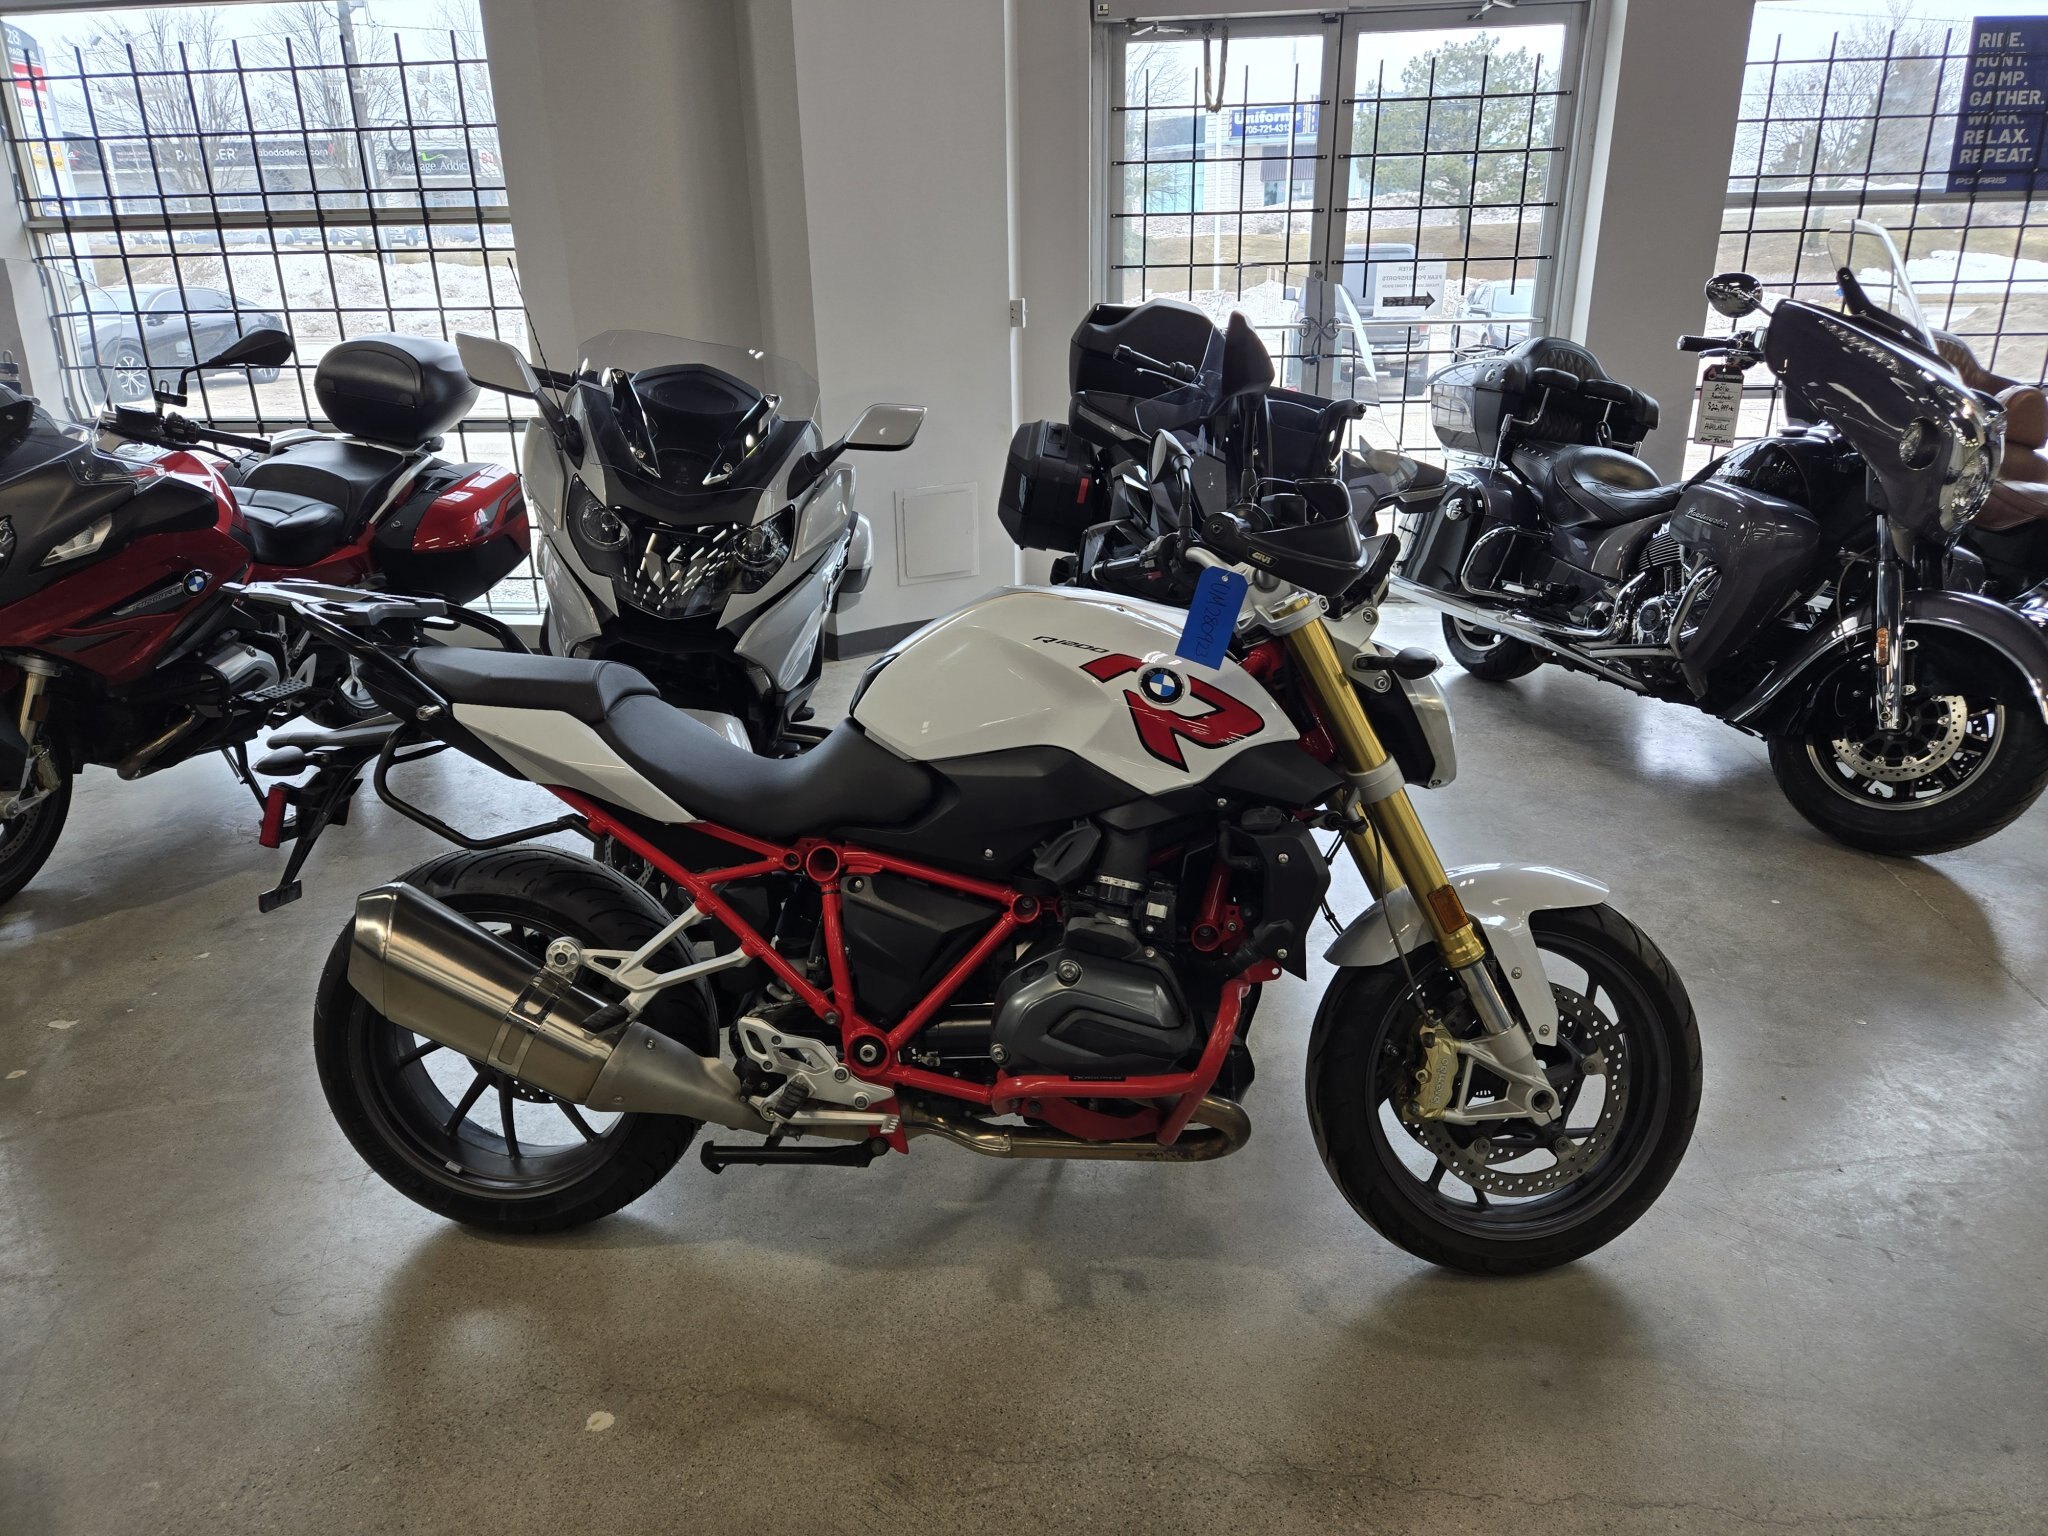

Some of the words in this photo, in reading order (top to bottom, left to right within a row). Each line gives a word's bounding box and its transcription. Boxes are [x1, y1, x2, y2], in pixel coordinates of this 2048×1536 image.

[1972, 71, 2029, 87] CAMP.
[1969, 90, 2046, 107] GATHER.
[1234, 110, 1302, 124] Uniforms
[1962, 128, 2029, 145] RELAX.
[258, 148, 328, 157] abodadecocom
[1959, 148, 2034, 164] REPEAT.
[396, 161, 436, 173] Masage
[440, 160, 471, 172] Addic
[1955, 177, 2008, 185] POARIS
[1251, 551, 1272, 564] GIVI
[1431, 1058, 1448, 1105] brembo
